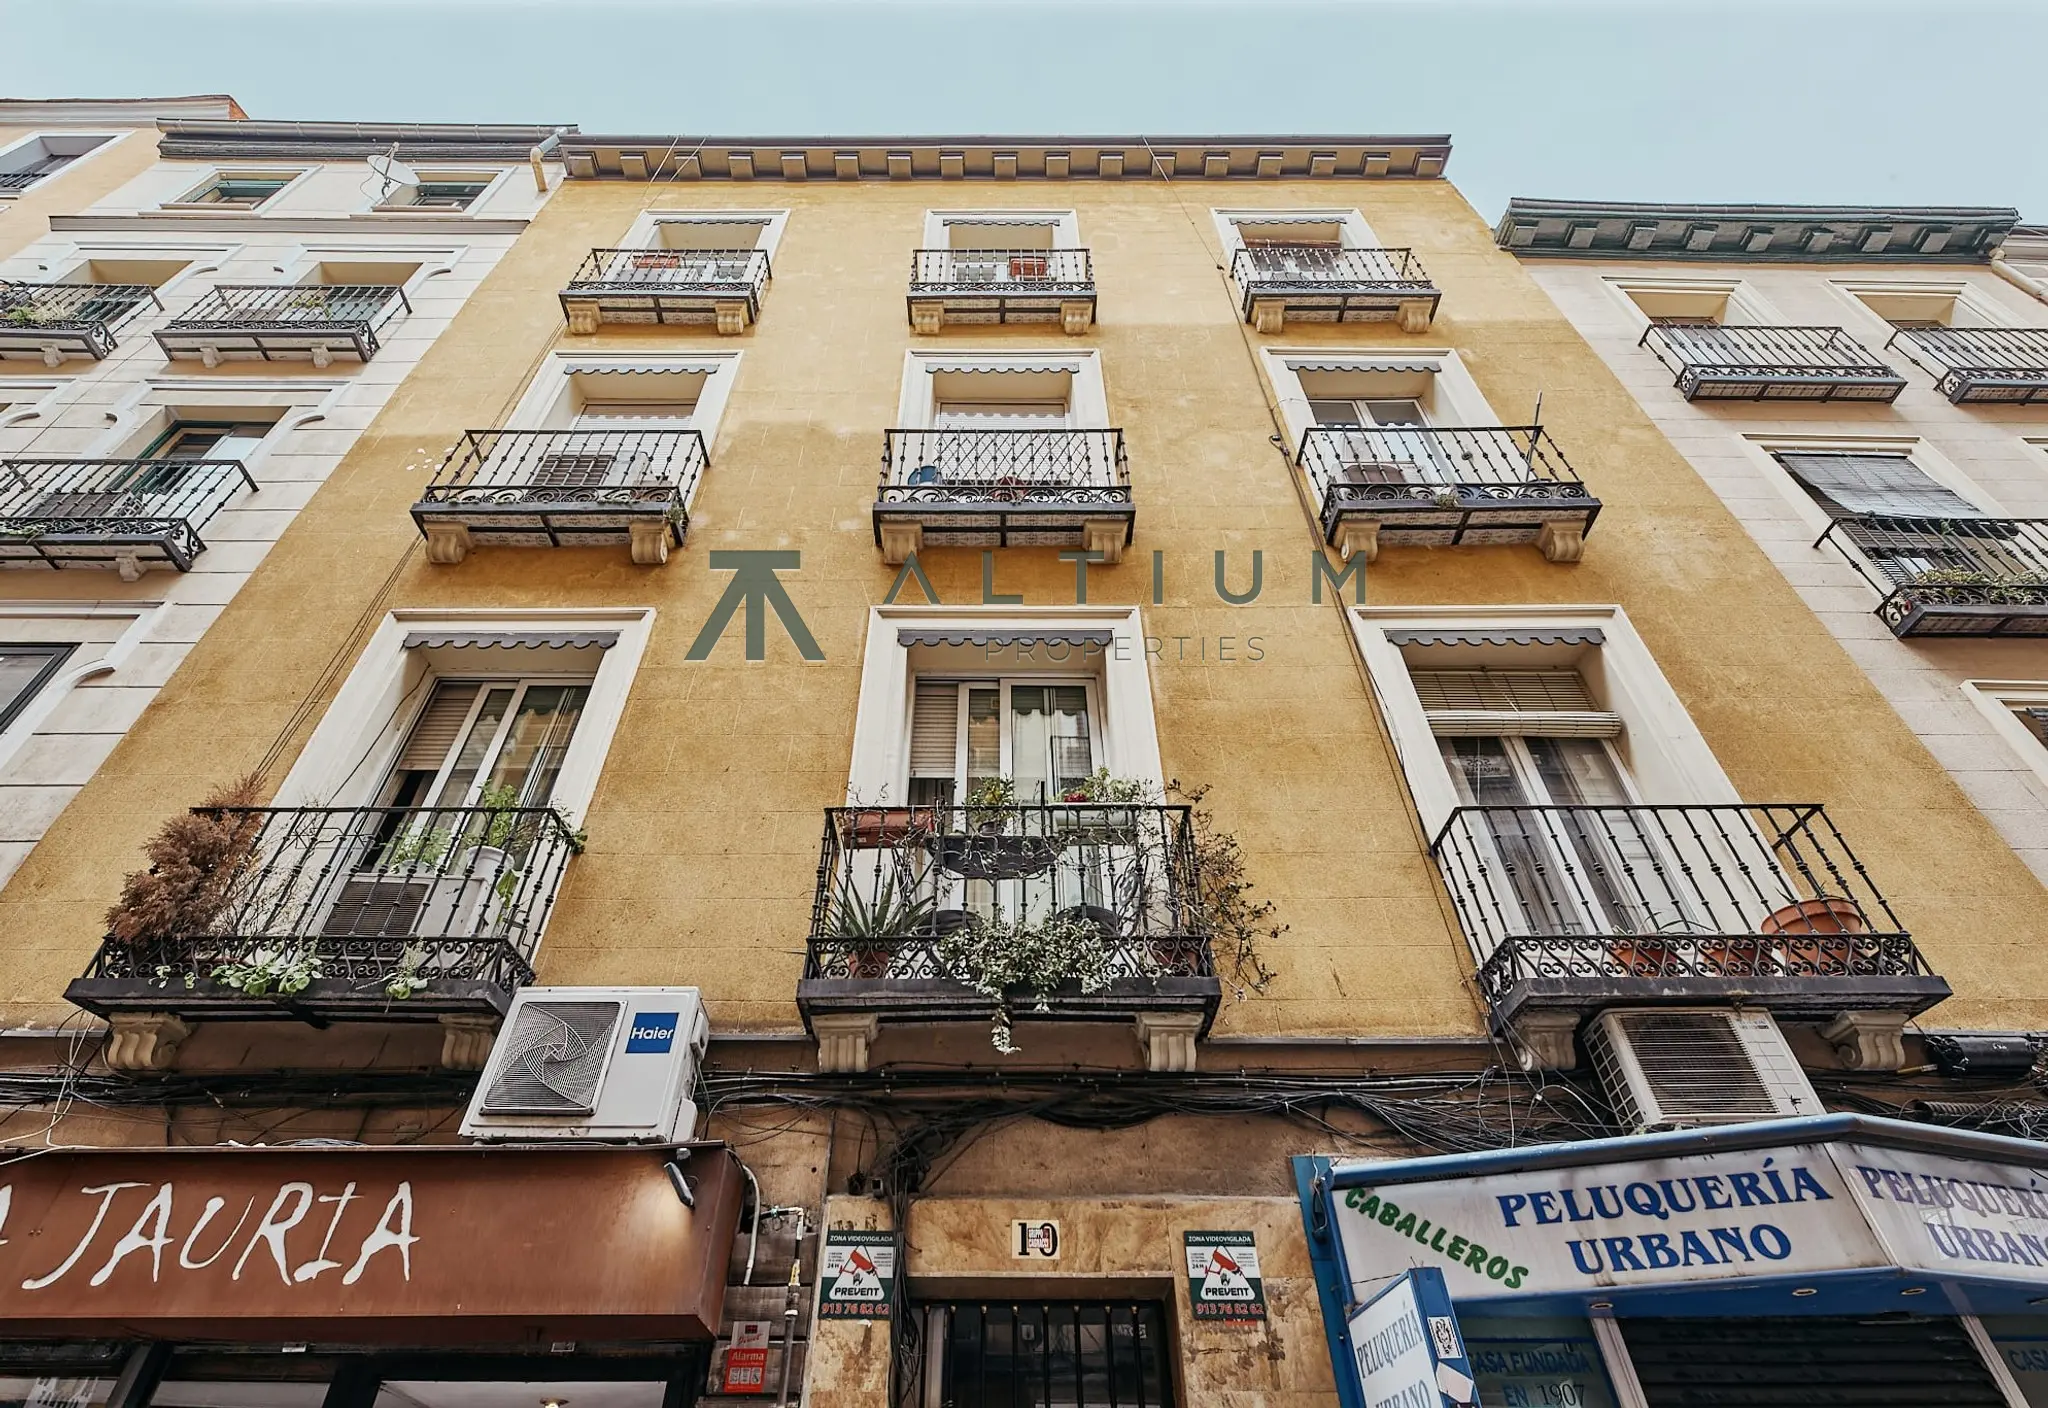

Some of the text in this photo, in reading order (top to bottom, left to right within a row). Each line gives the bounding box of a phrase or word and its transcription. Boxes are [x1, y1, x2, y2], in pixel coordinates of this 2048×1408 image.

[631, 1026, 674, 1040] Haier
[1496, 1157, 1834, 1228] PELUQUERÍA
[22, 1181, 421, 1290] JAURIA
[1018, 1222, 1058, 1257] 10
[1345, 1187, 1529, 1289] CABALLEROS
[1923, 1222, 2048, 1268] URBAN
[1566, 1224, 1792, 1275] URBANO
[834, 1287, 880, 1297] PREVENT
[1205, 1287, 1249, 1297] PREVENT
[821, 1302, 843, 1314] 913
[843, 1302, 858, 1314] 76
[1196, 1303, 1217, 1314] 913
[1218, 1303, 1233, 1314] 76
[1356, 1302, 1424, 1379] PELUQUERÍA
[731, 1351, 764, 1361] Alarma
[1508, 1350, 1594, 1374] FUNDADA
[1502, 1382, 1585, 1408] EN 1907
